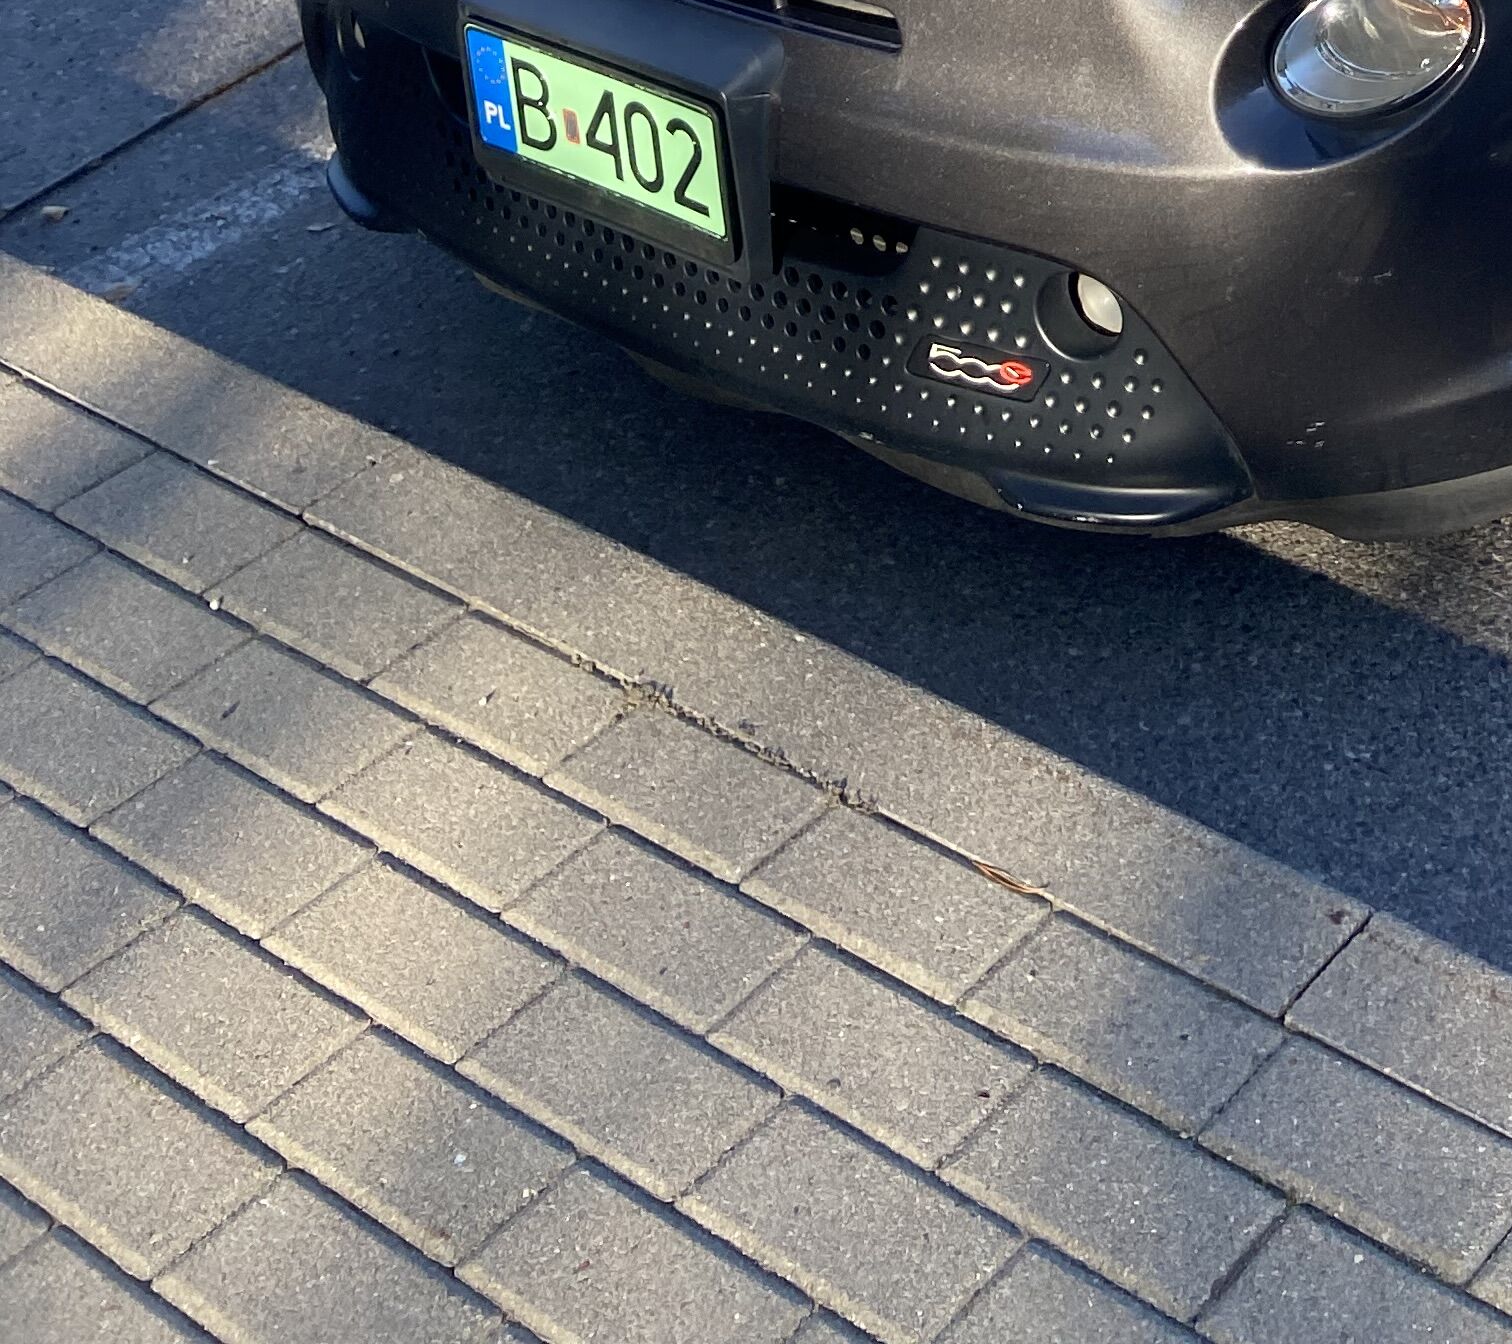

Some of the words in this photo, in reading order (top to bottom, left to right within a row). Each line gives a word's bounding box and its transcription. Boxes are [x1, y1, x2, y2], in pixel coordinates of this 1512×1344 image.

[483, 99, 512, 131] PL
[510, 56, 558, 152] B
[585, 88, 711, 218] 402
